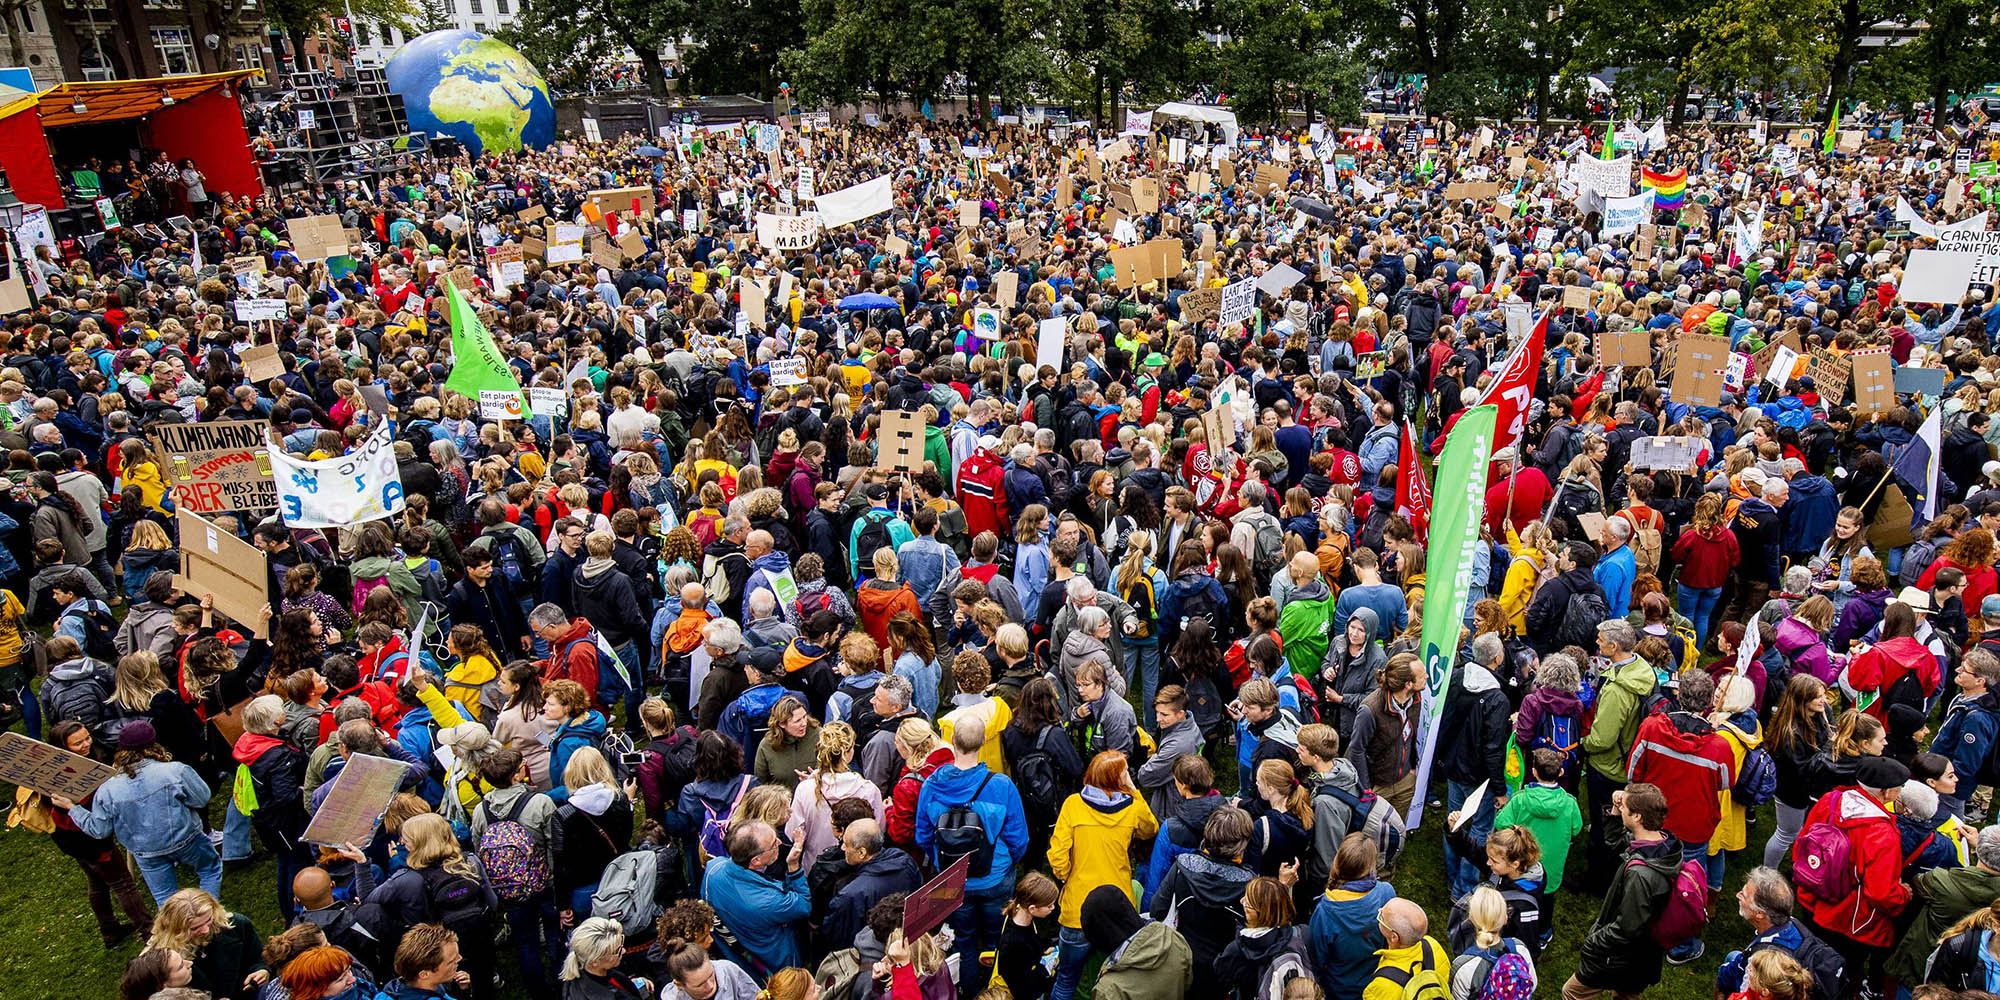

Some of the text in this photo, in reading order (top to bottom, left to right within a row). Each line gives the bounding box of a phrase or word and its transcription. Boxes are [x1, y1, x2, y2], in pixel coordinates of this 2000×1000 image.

[1225, 280, 1253, 299] LAAT DE
[770, 361, 782, 369] Eet
[1819, 360, 1849, 380] ECONOMY
[481, 391, 492, 399] Eet
[192, 451, 255, 481] STOPPEN
[176, 482, 226, 512] BIER
[44, 772, 73, 788] HOT
[60, 764, 110, 798] PLANET
